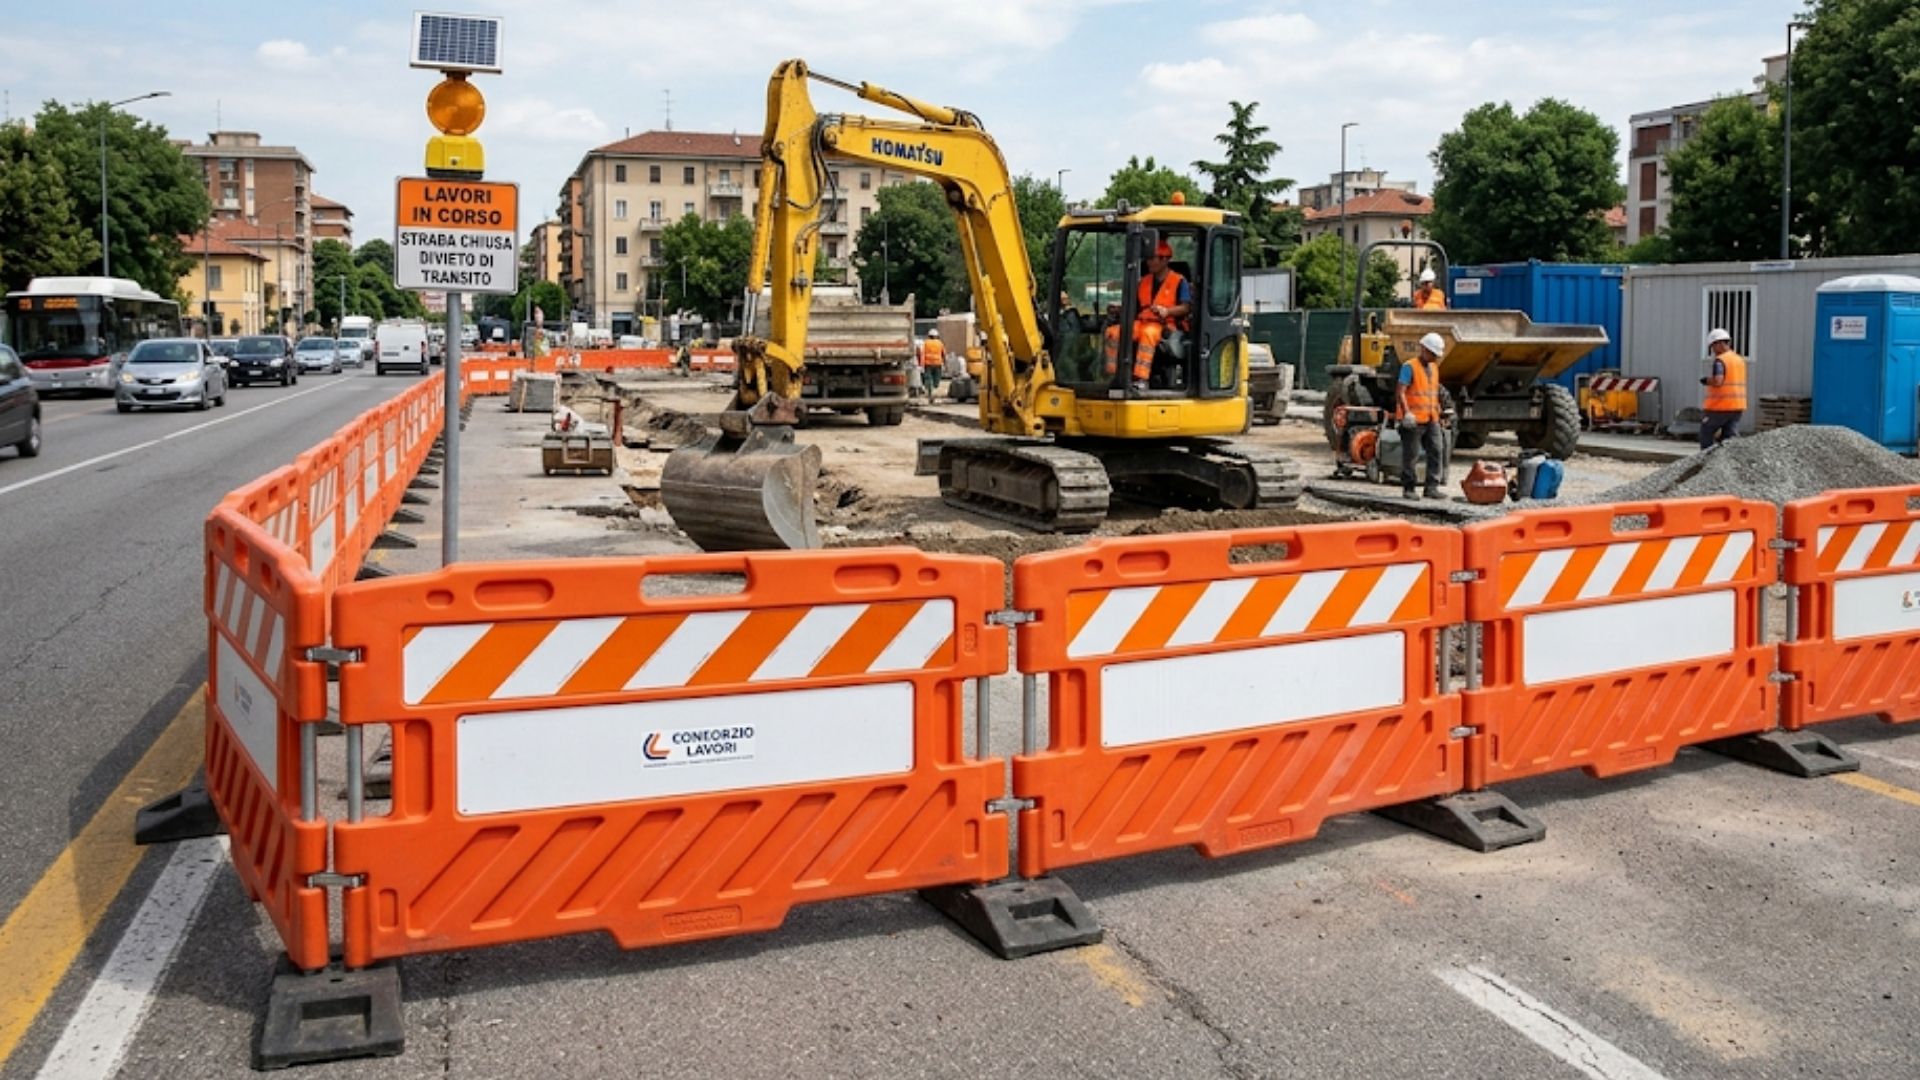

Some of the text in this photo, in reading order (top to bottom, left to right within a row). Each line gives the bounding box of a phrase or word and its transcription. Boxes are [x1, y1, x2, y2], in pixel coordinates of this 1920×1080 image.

[424, 186, 491, 203] LAVORI
[412, 207, 502, 225] IN CORSO
[460, 234, 512, 250] CHIUSA
[419, 251, 493, 267] DIVIETO DI
[421, 269, 491, 285] TRANSITO
[686, 742, 737, 757] LAVORI
